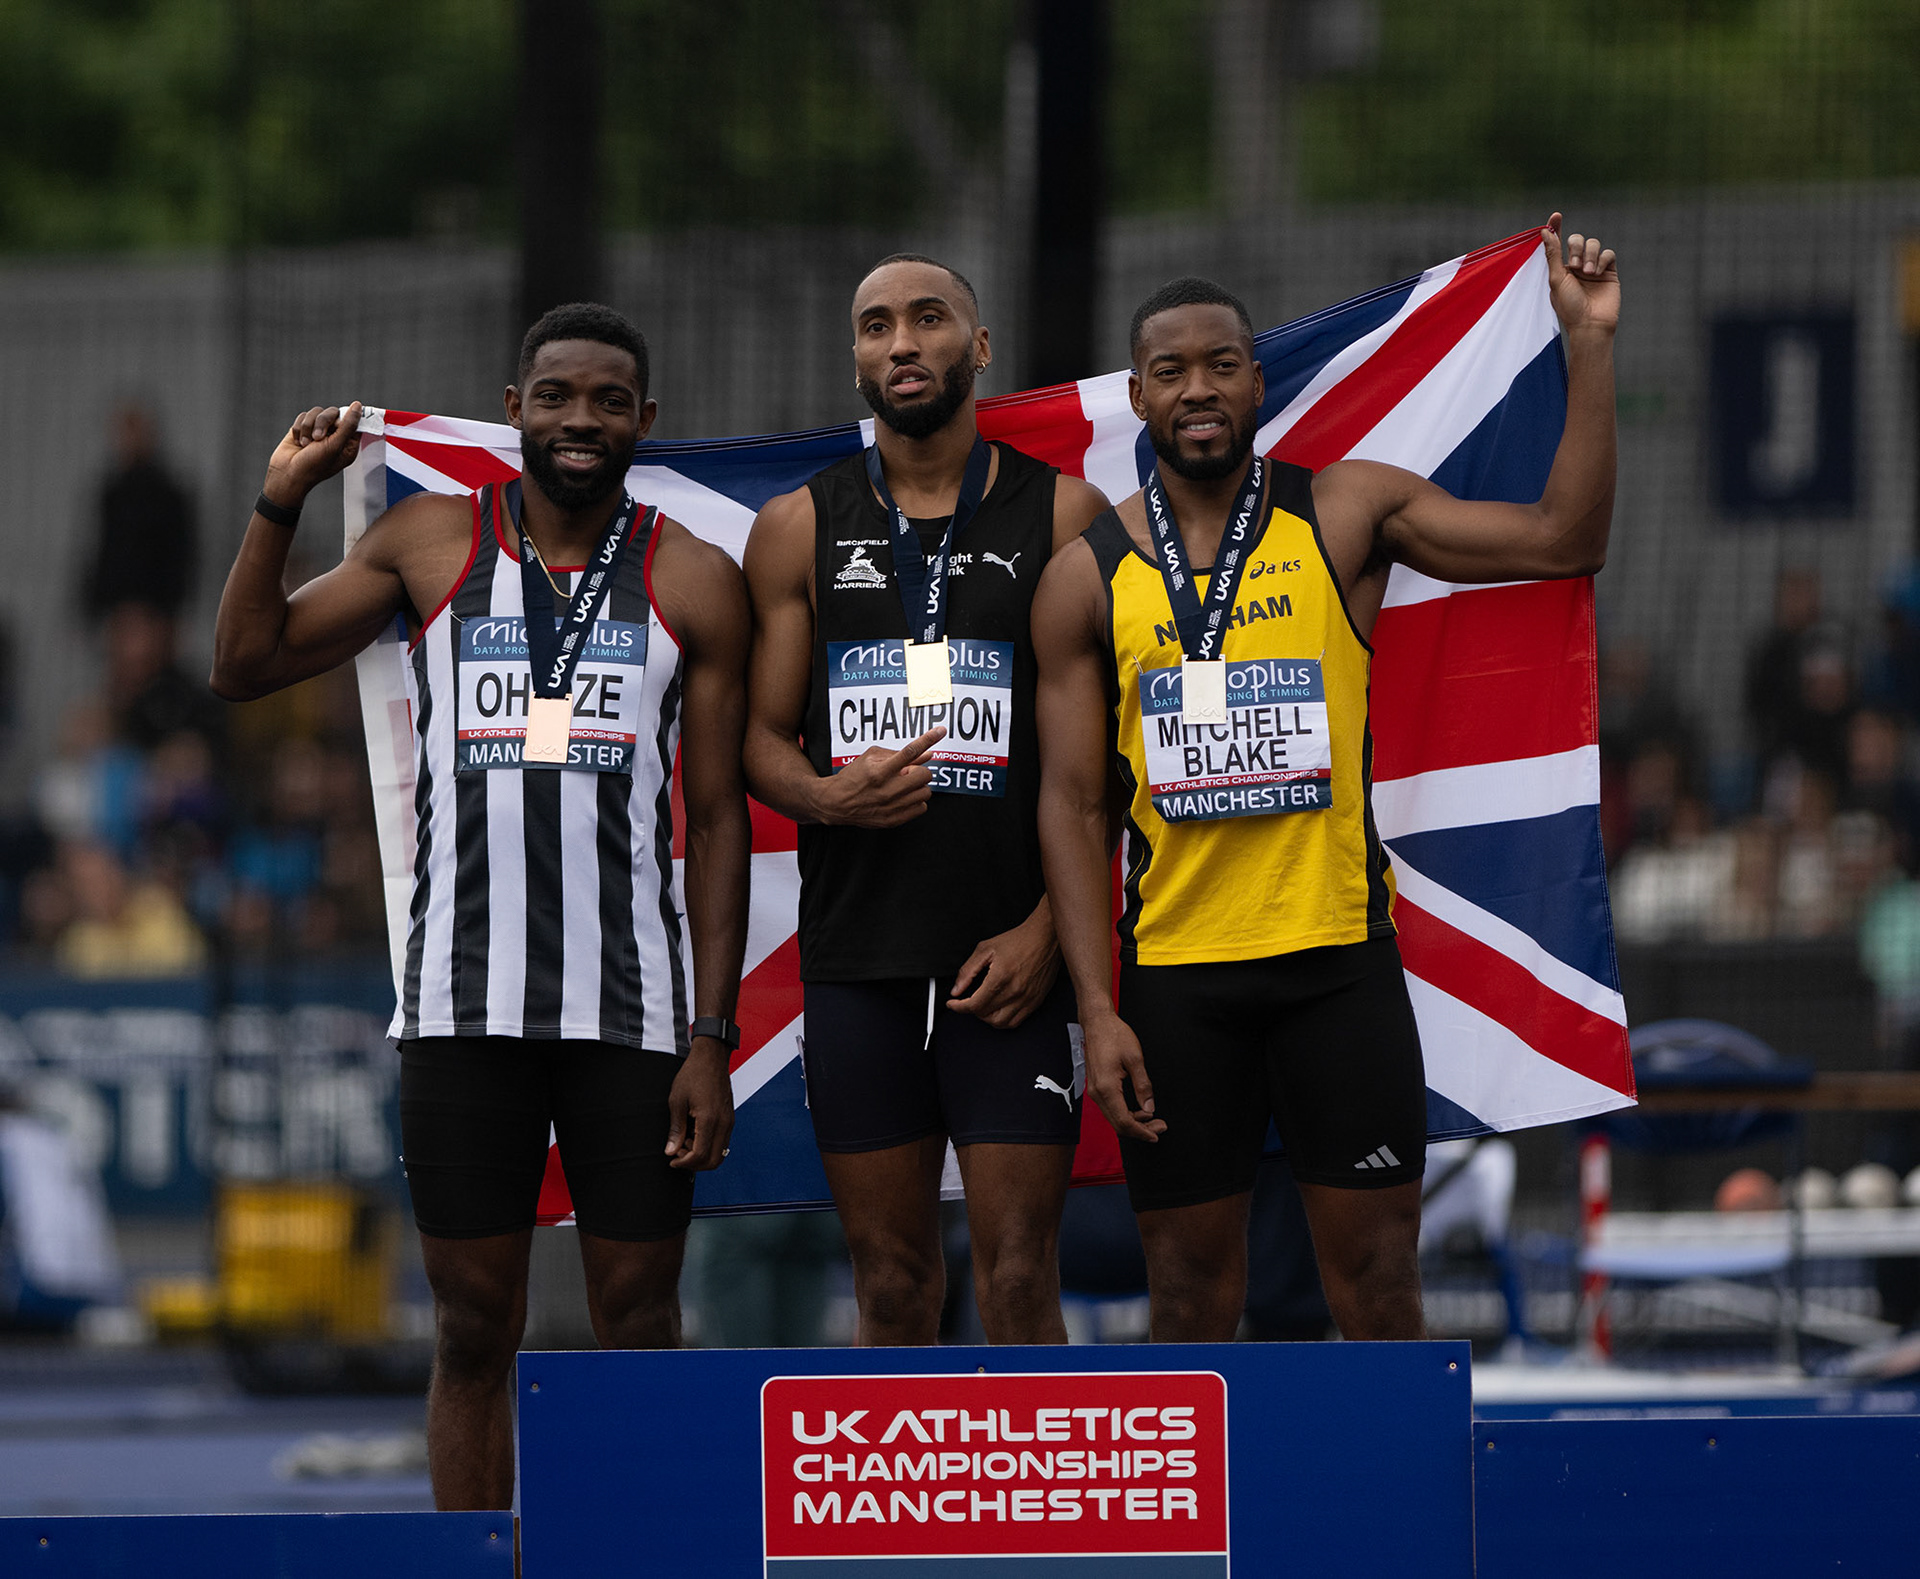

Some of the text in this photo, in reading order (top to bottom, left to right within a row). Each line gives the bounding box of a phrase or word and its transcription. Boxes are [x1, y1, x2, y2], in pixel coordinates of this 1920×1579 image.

[1150, 487, 1162, 521] UKA
[1232, 512, 1250, 541] UKA
[600, 534, 620, 565] UKA
[836, 539, 889, 547] BIRCHFIELD
[1163, 541, 1180, 573] UKA
[927, 553, 973, 567] Kght
[833, 582, 887, 590] HARRIERS
[927, 577, 940, 614] UKA
[1215, 569, 1233, 601] UKA
[573, 590, 597, 623] UKA
[1153, 594, 1293, 647] NHAM
[474, 646, 501, 655] DATA
[591, 647, 631, 658] TIMING
[841, 642, 1000, 671] Miclus
[547, 653, 570, 688] UKA
[843, 671, 870, 681] DATA
[958, 670, 998, 681] TIMING
[1150, 661, 1311, 702] Moplus
[476, 672, 624, 720] OHZE
[1154, 697, 1181, 708] DATA
[1260, 689, 1267, 698] &
[1270, 688, 1310, 697] TIMING
[468, 728, 625, 741] UK ATHLETI PIONSHIPS
[839, 697, 1001, 744] CHAMPION
[469, 743, 624, 766] MANSTER
[932, 751, 996, 764] MPIONSHIPS
[1184, 739, 1289, 778] BLAKE
[927, 765, 993, 791] ESTER
[1159, 769, 1319, 792] UK ATHLETICS CHAMPIONSHIPS
[1162, 784, 1319, 818] MANCHESTER
[792, 1406, 1198, 1445] UK ATHLETICS
[792, 1449, 1199, 1483] CHAMPIONSHIPS
[793, 1487, 1199, 1525] MANCHESTER
